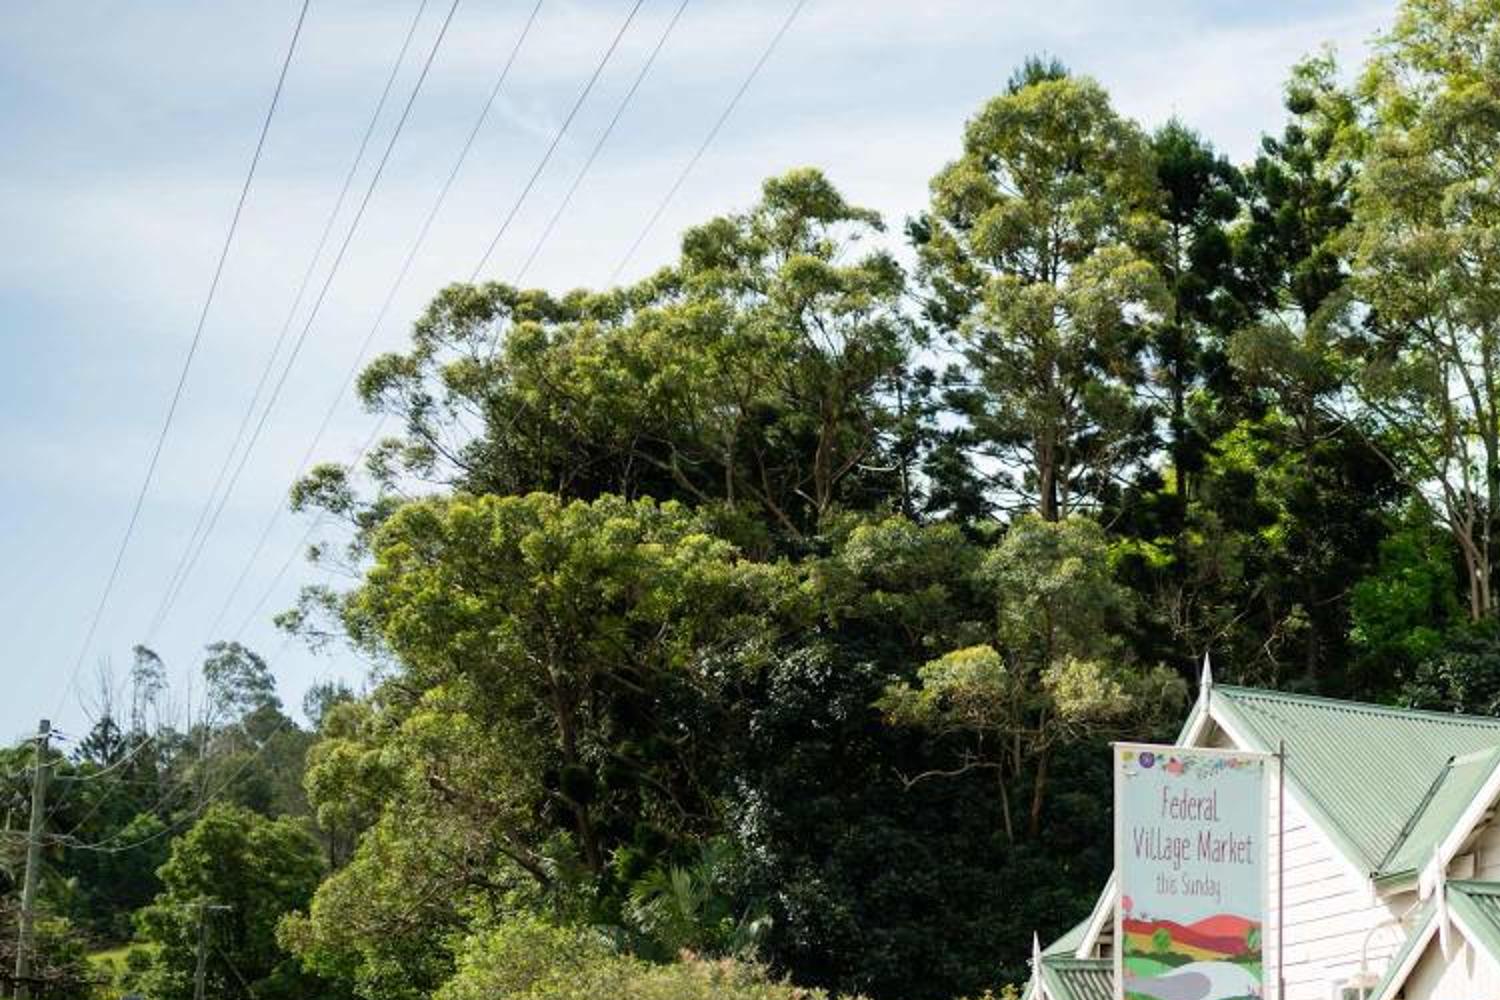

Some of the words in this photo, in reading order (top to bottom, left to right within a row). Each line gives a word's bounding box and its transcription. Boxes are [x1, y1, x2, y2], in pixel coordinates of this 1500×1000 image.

[1161, 785, 1221, 822] Federal
[1133, 827, 1191, 871] Village
[1197, 831, 1254, 865] Market
[1156, 872, 1178, 895] this
[1181, 873, 1222, 904] Sunday
